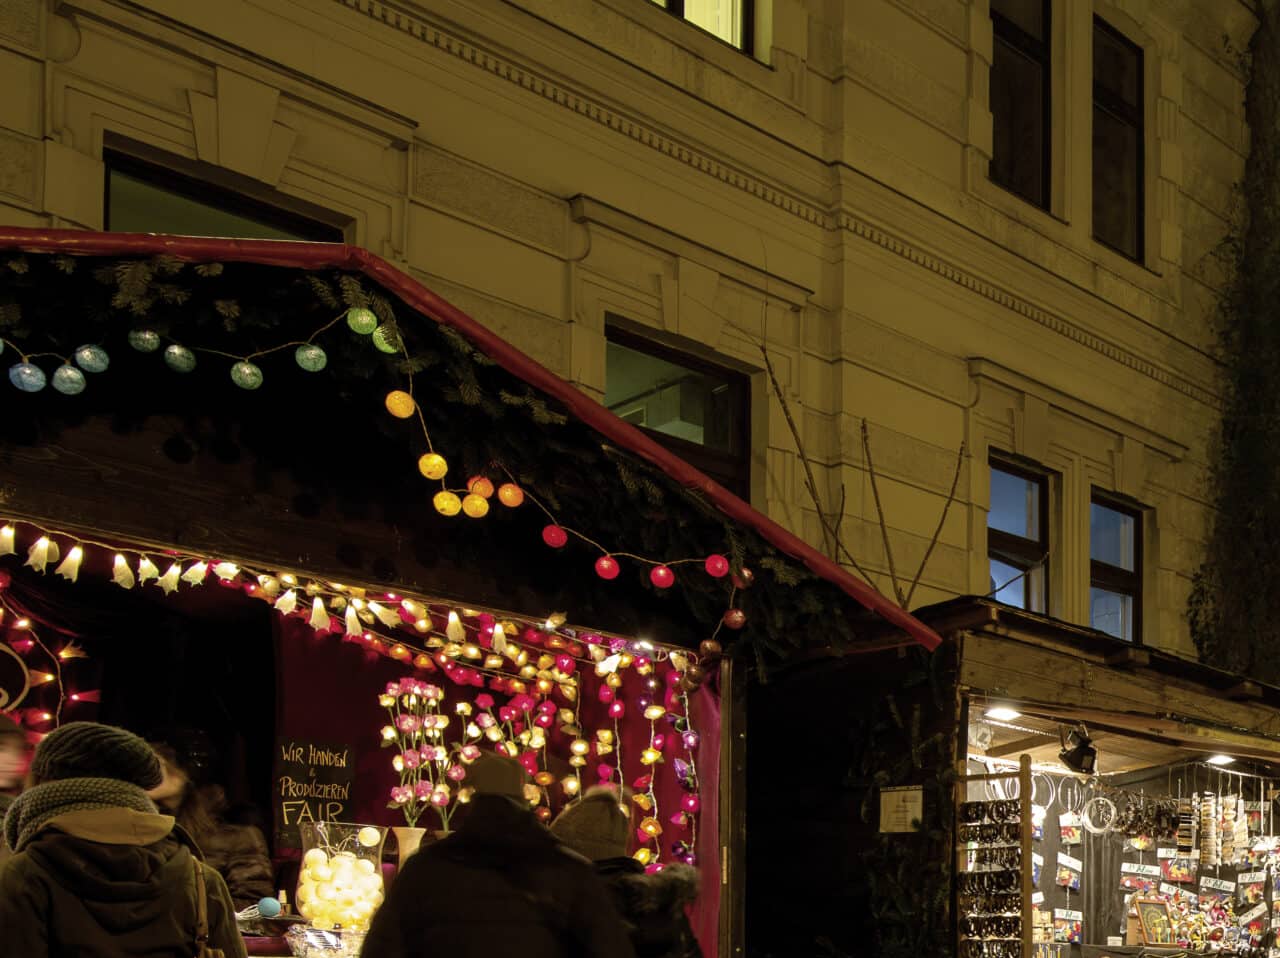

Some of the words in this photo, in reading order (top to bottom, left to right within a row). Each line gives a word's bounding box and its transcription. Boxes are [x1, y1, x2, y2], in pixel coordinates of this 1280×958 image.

[282, 742, 304, 765] WIR
[280, 776, 350, 799] PRODUZIEREN
[282, 800, 343, 825] FAIR
